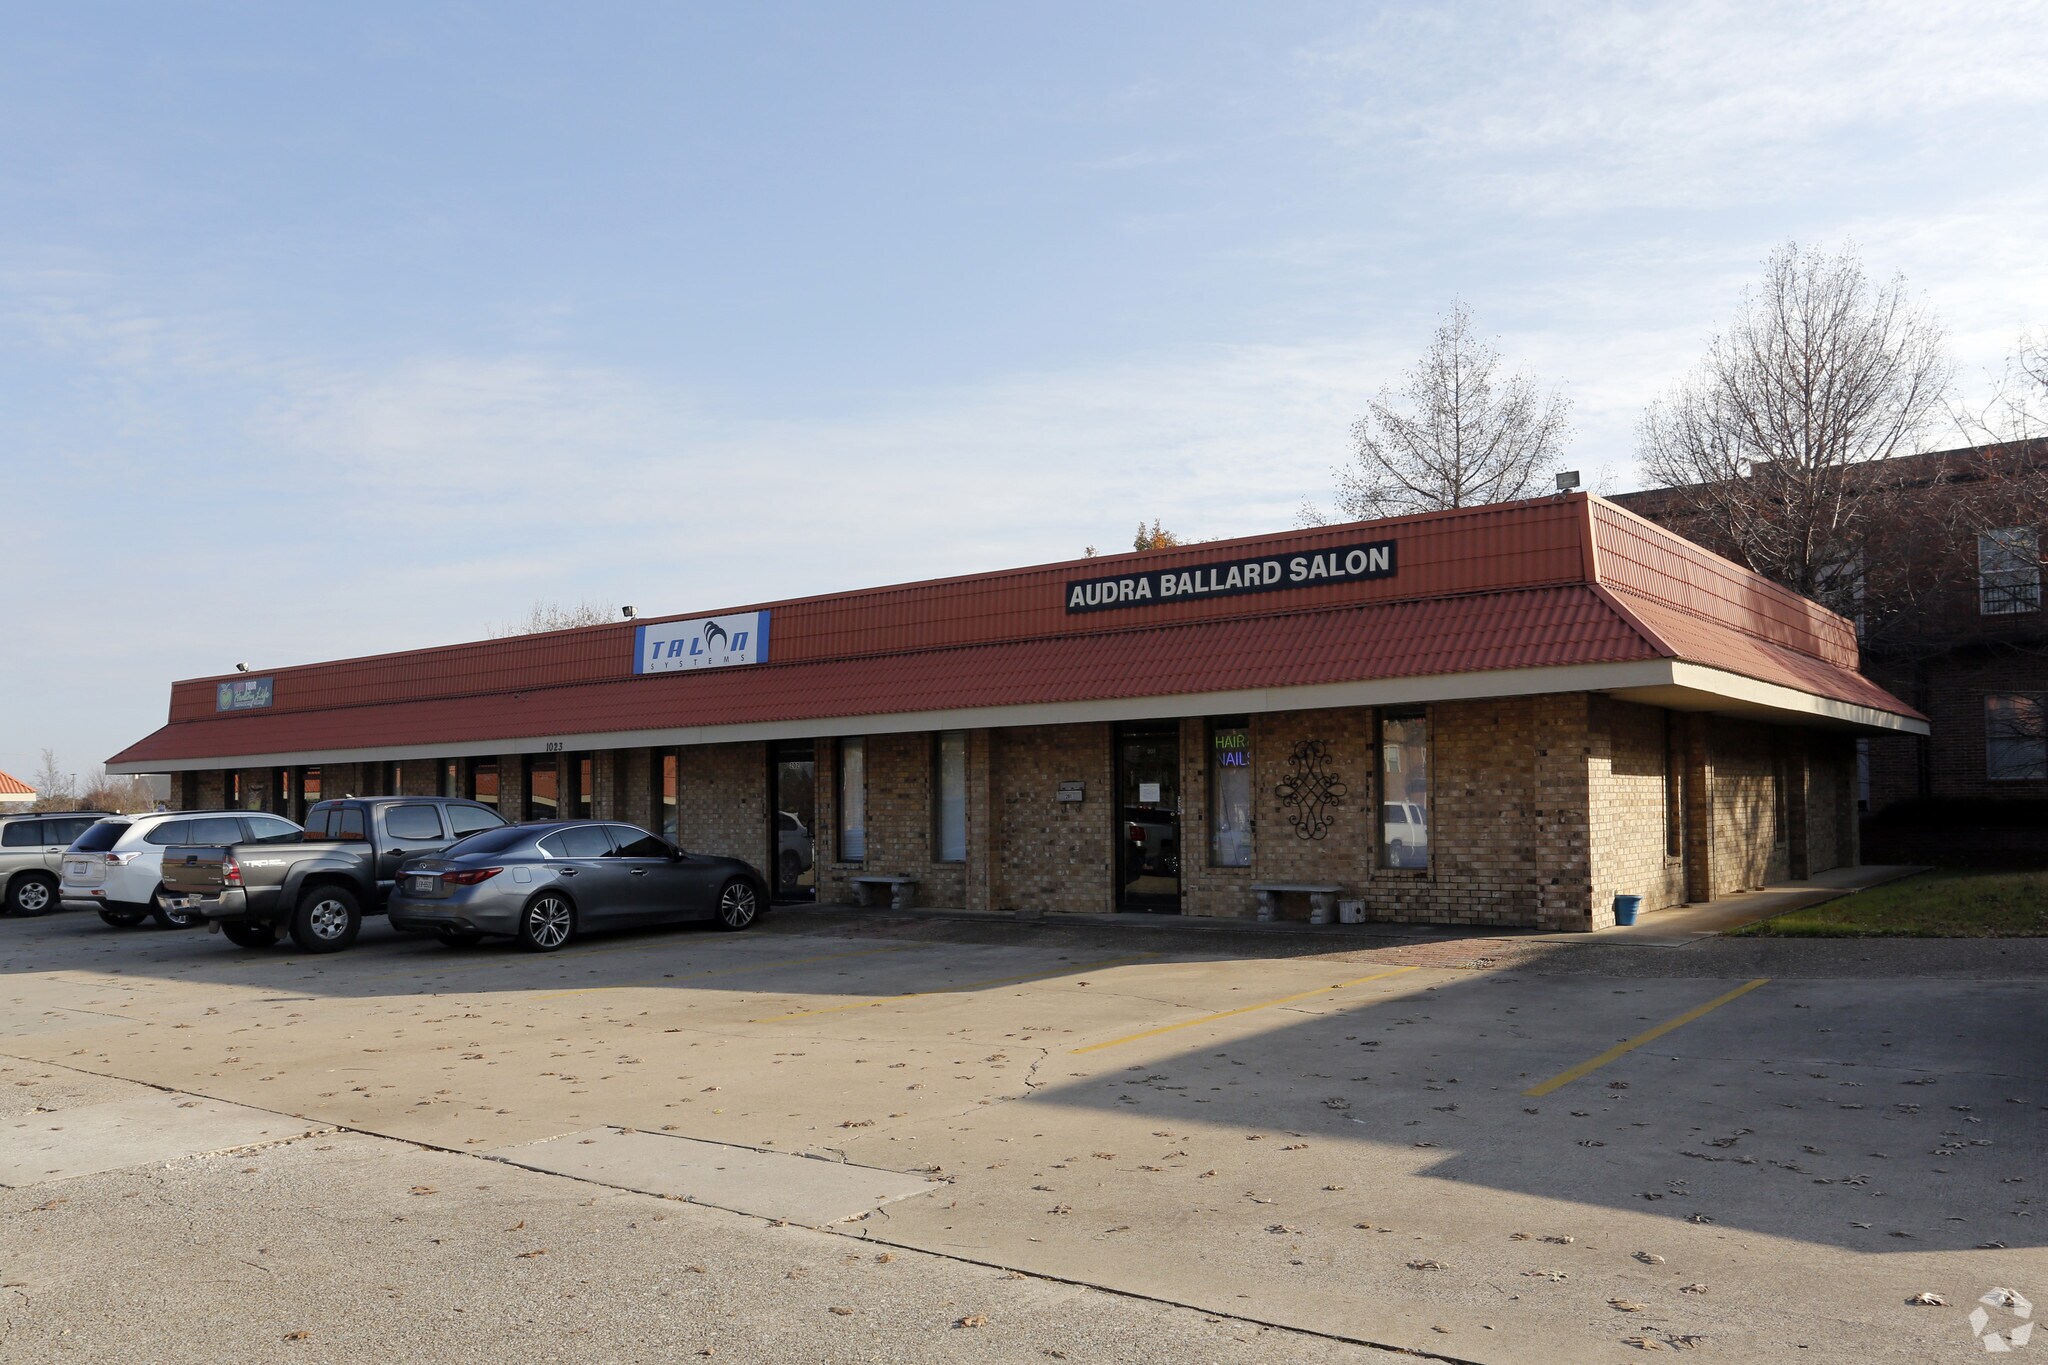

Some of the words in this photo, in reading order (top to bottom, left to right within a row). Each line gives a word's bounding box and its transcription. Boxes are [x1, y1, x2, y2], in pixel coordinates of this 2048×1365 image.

[1069, 577, 1152, 608] AUDRA
[1160, 561, 1282, 597] BALLARD
[1289, 546, 1389, 582] SALON
[650, 654, 745, 670] SYSTEMS
[546, 742, 563, 752] 1023
[1215, 734, 1246, 749] HAIR
[1217, 751, 1250, 767] NAILS
